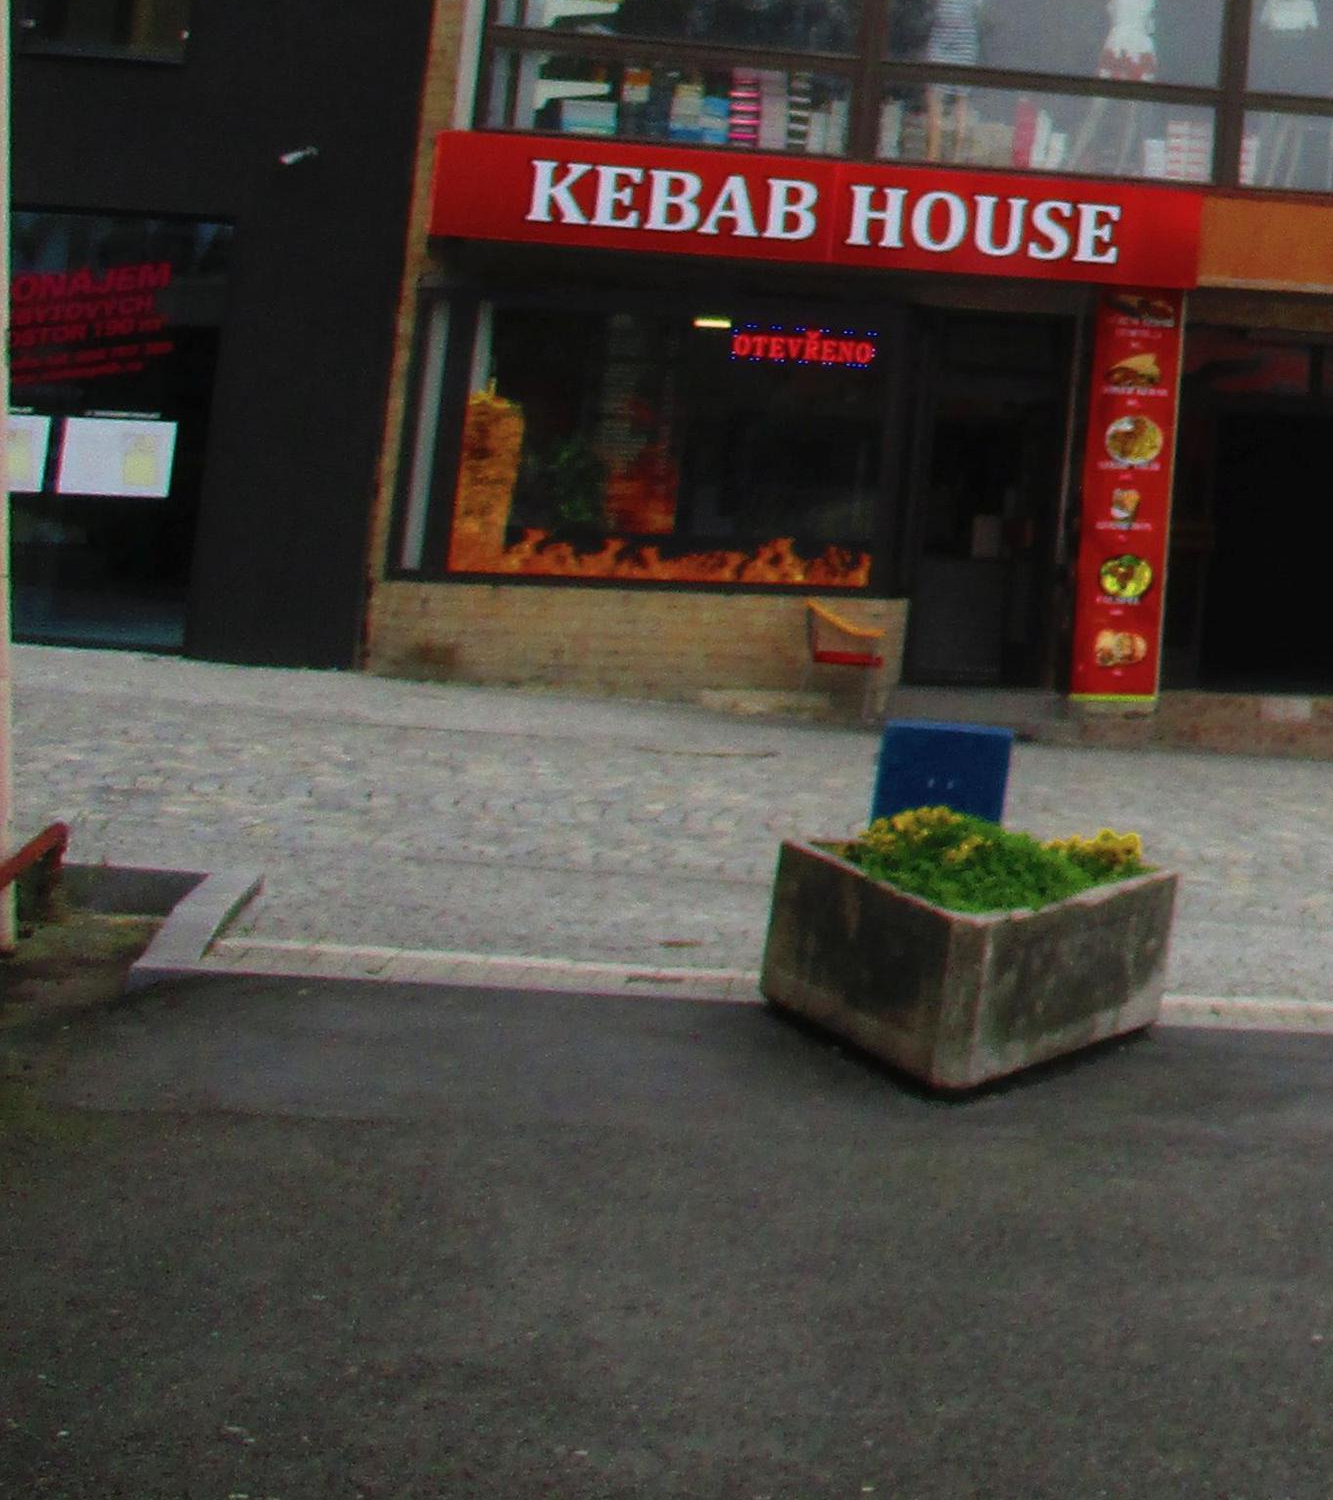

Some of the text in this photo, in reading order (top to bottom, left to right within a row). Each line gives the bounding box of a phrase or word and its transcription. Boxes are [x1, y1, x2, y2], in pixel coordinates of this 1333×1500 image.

[524, 159, 1122, 264] KEBAB HOUSE
[732, 331, 874, 364] OTEVŘENO
